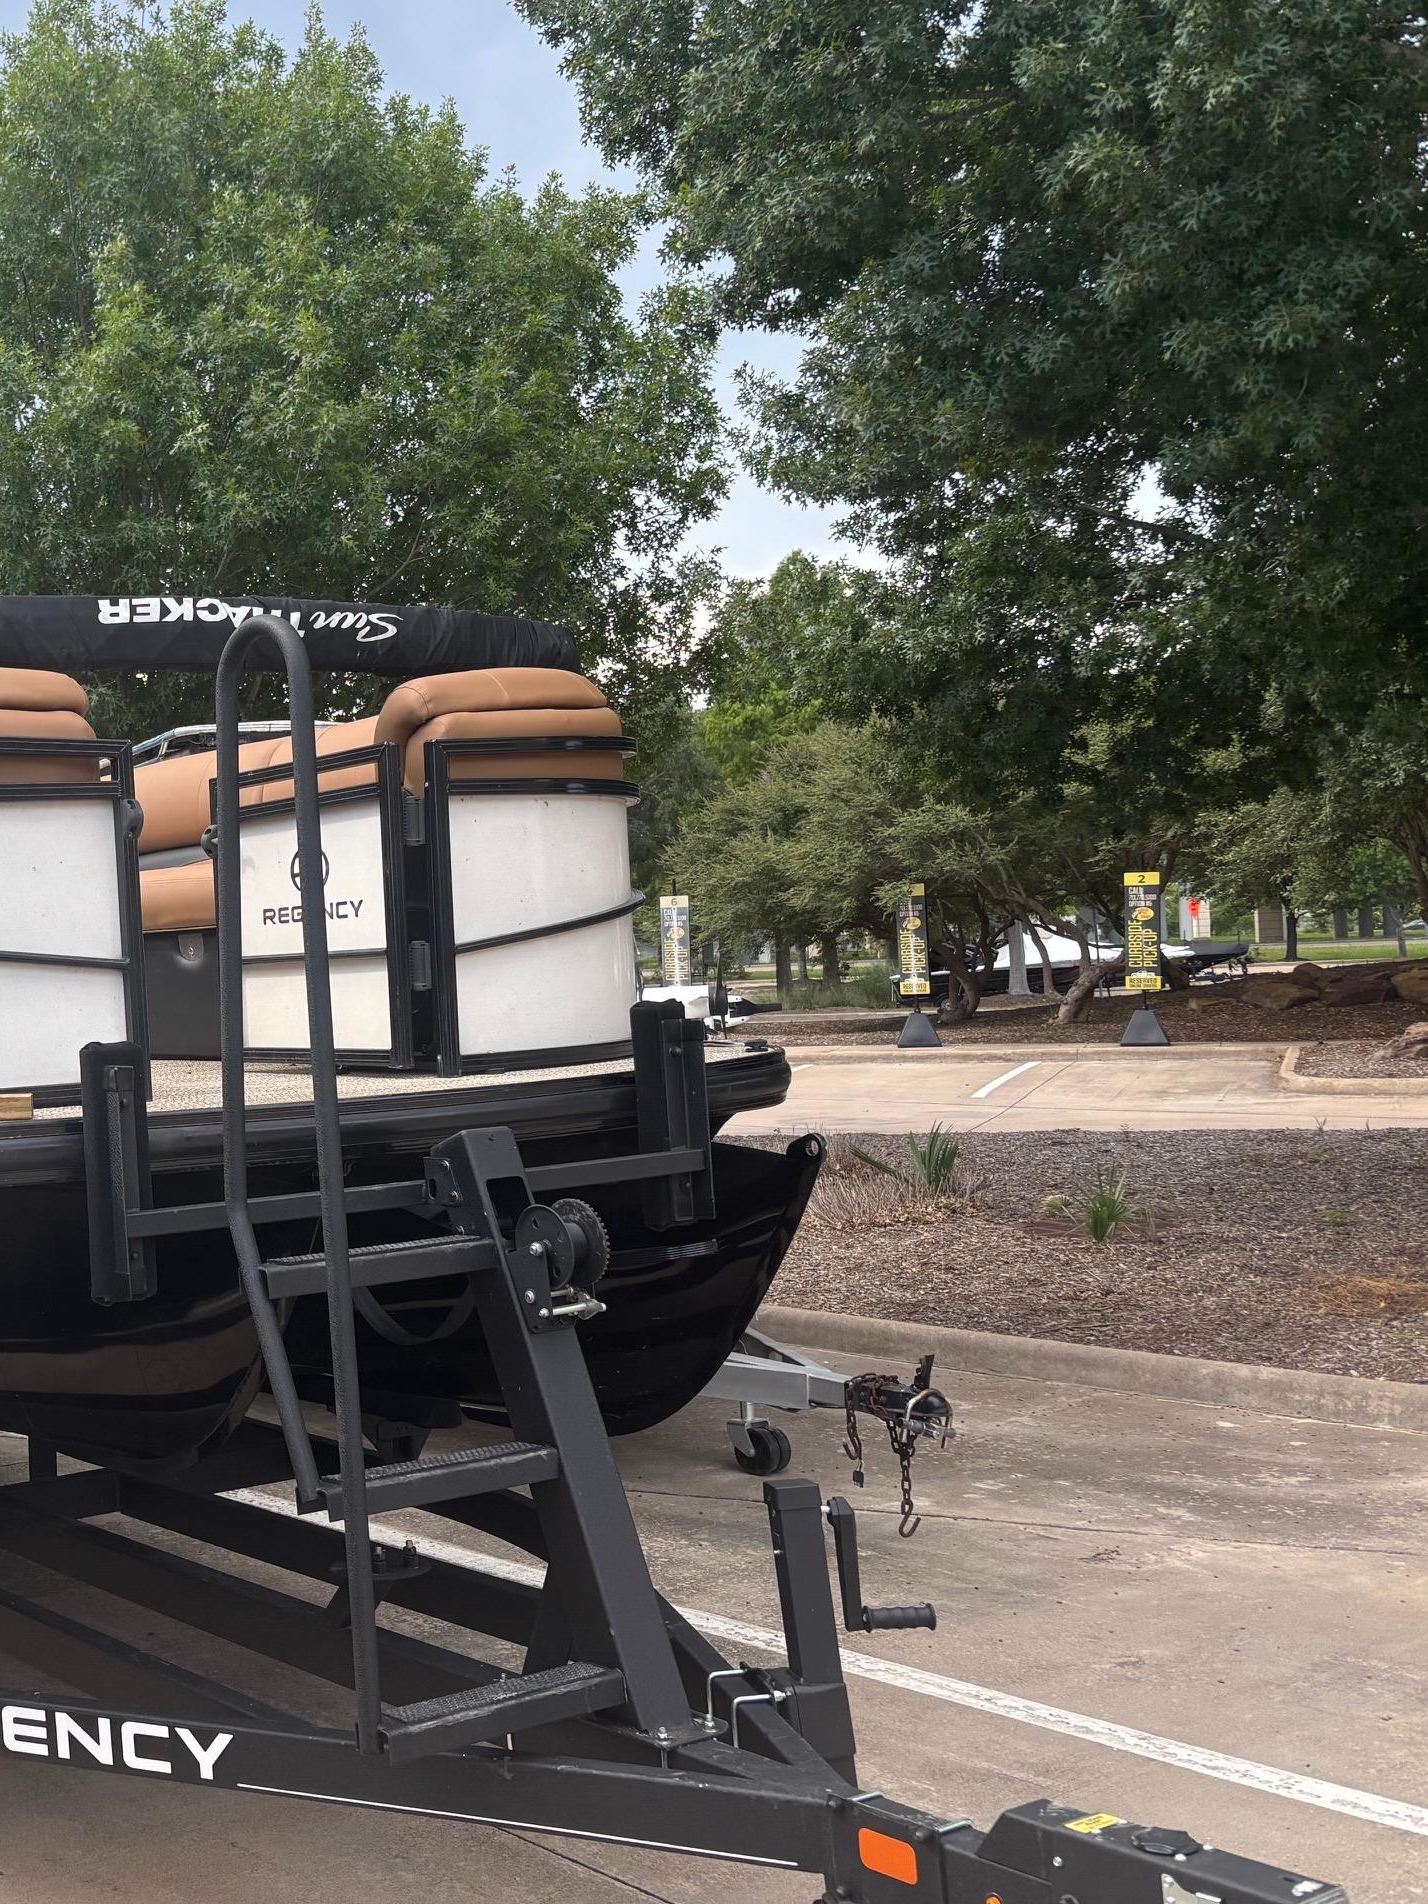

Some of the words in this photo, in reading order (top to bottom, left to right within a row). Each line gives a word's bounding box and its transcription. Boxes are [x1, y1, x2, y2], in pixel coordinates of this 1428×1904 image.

[98, 597, 305, 638] TACKER
[309, 610, 404, 642] Sun
[1137, 874, 1146, 884] 2
[262, 898, 364, 926] REGNCY
[670, 897, 678, 906] 6
[899, 929, 914, 974] CURBSIDE
[913, 933, 927, 973] PICK-UP
[1128, 919, 1143, 967] CURBSIDE
[1142, 928, 1158, 967] PICK-UP
